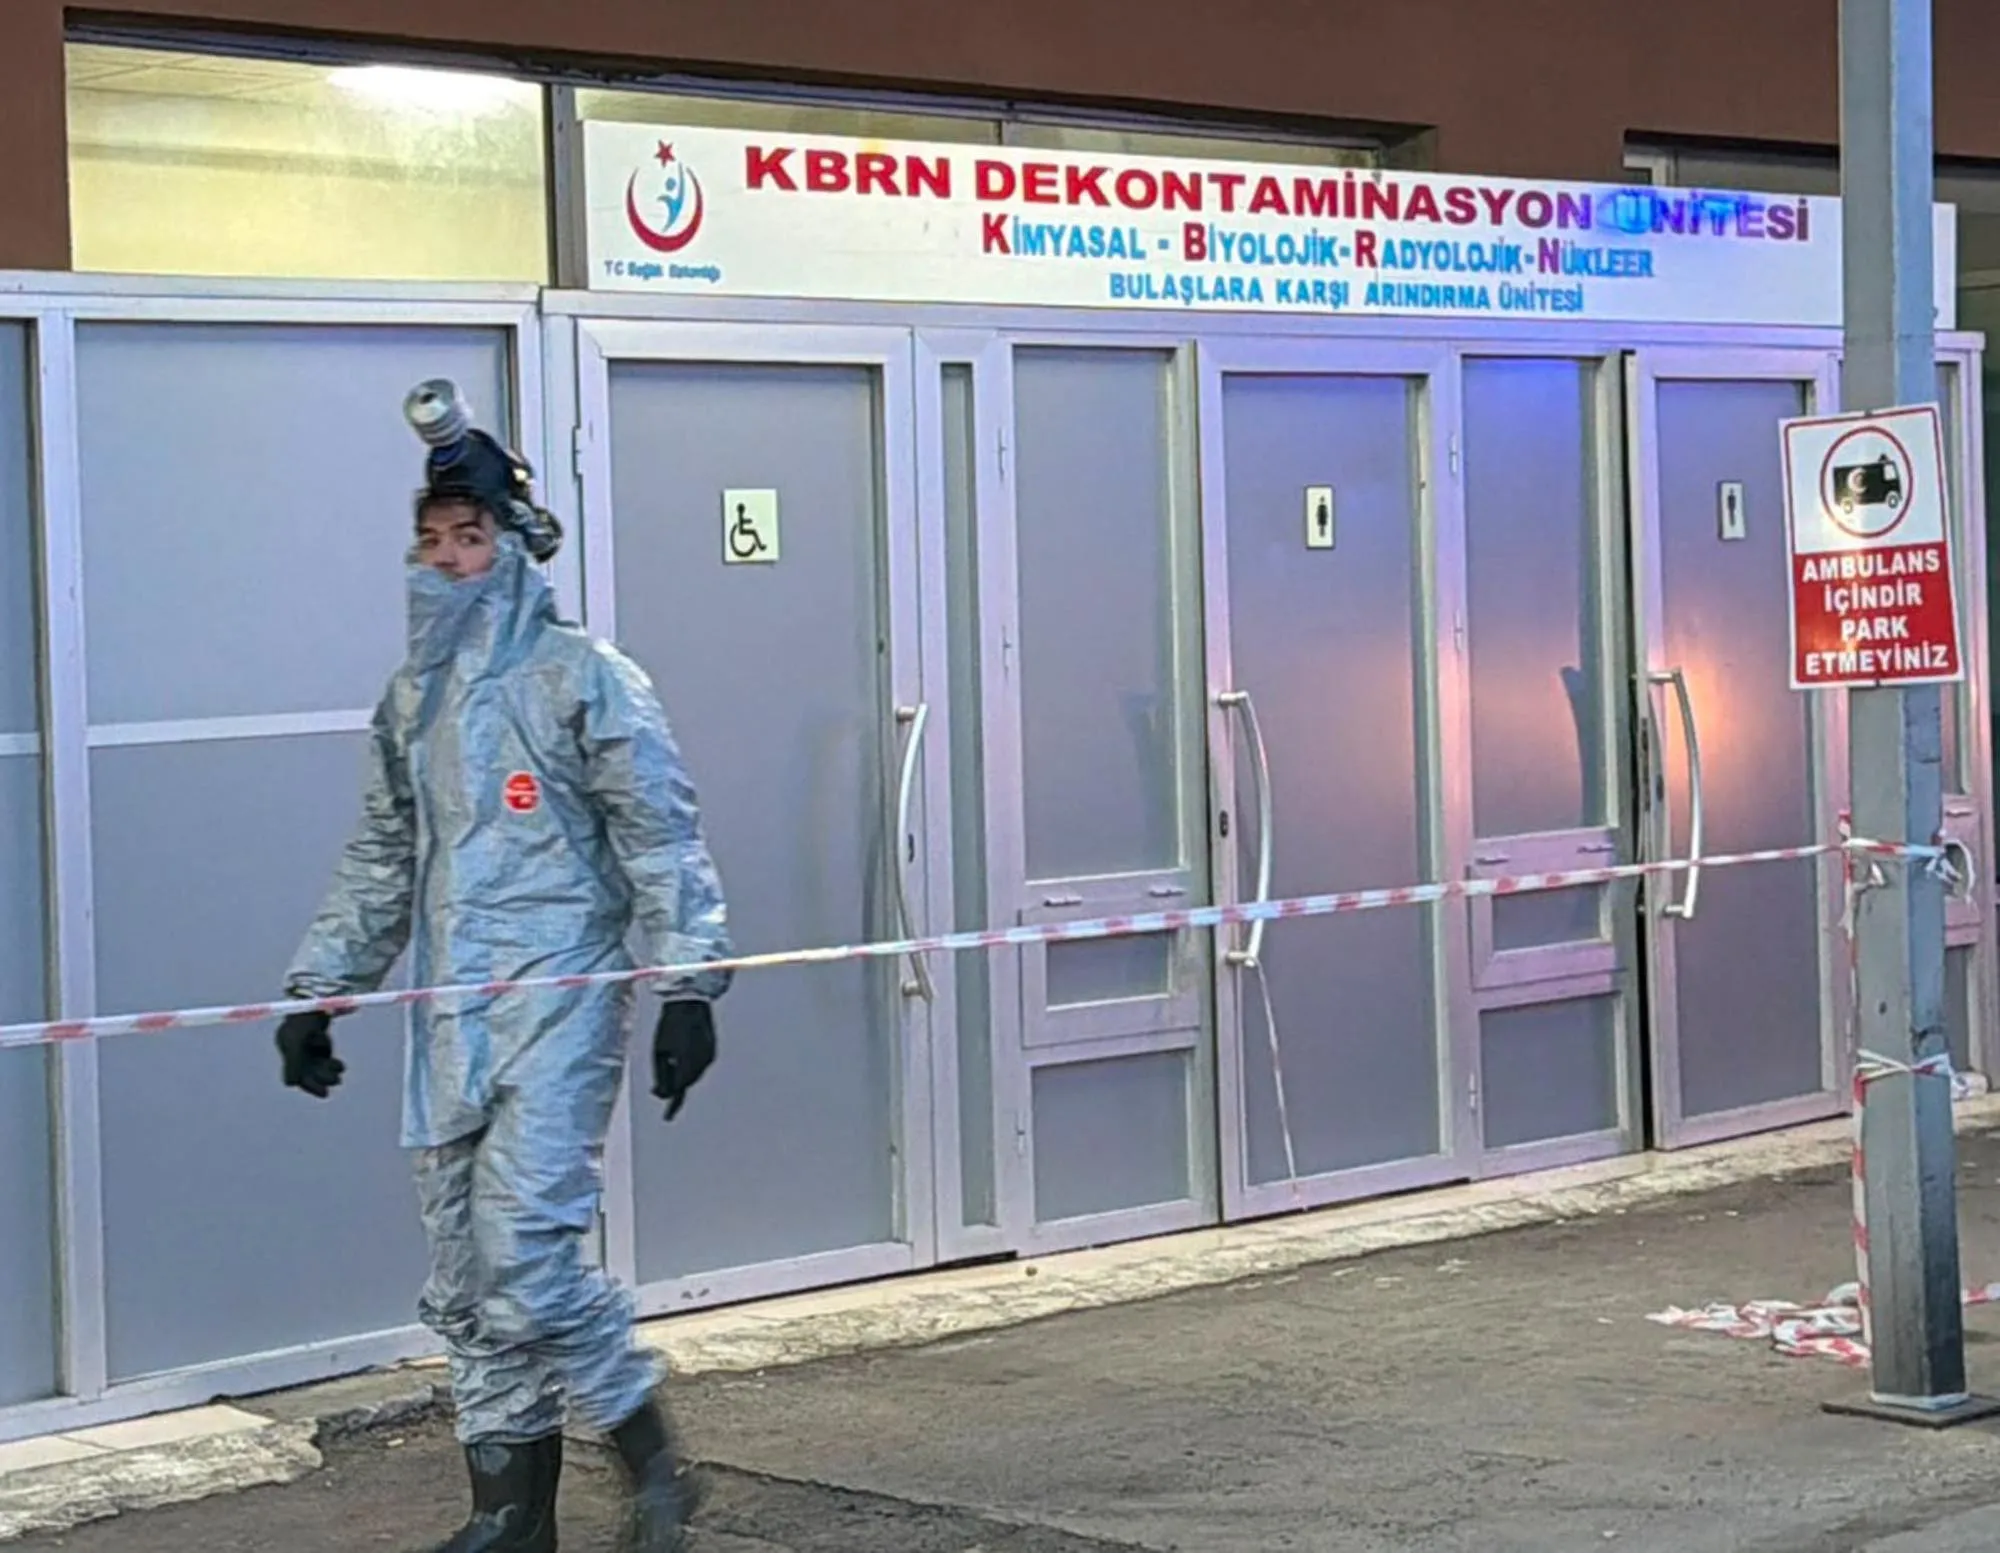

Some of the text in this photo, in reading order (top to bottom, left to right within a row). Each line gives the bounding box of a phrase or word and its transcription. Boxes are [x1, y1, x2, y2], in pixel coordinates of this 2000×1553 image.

[745, 146, 1809, 241] KBRN DEKONTAMİNASYON ÜNİTESİ
[982, 213, 1147, 260] KİMYASAL
[1110, 273, 1584, 312] BULAŞLARA KARŞI ARINDIRMA ÜNİTESİ
[1803, 549, 1940, 582] AMBULANS
[1825, 578, 1922, 617] İÇİNDİR
[1841, 616, 1909, 643] PARK
[1805, 640, 1949, 676] ETMEYİNİZ
